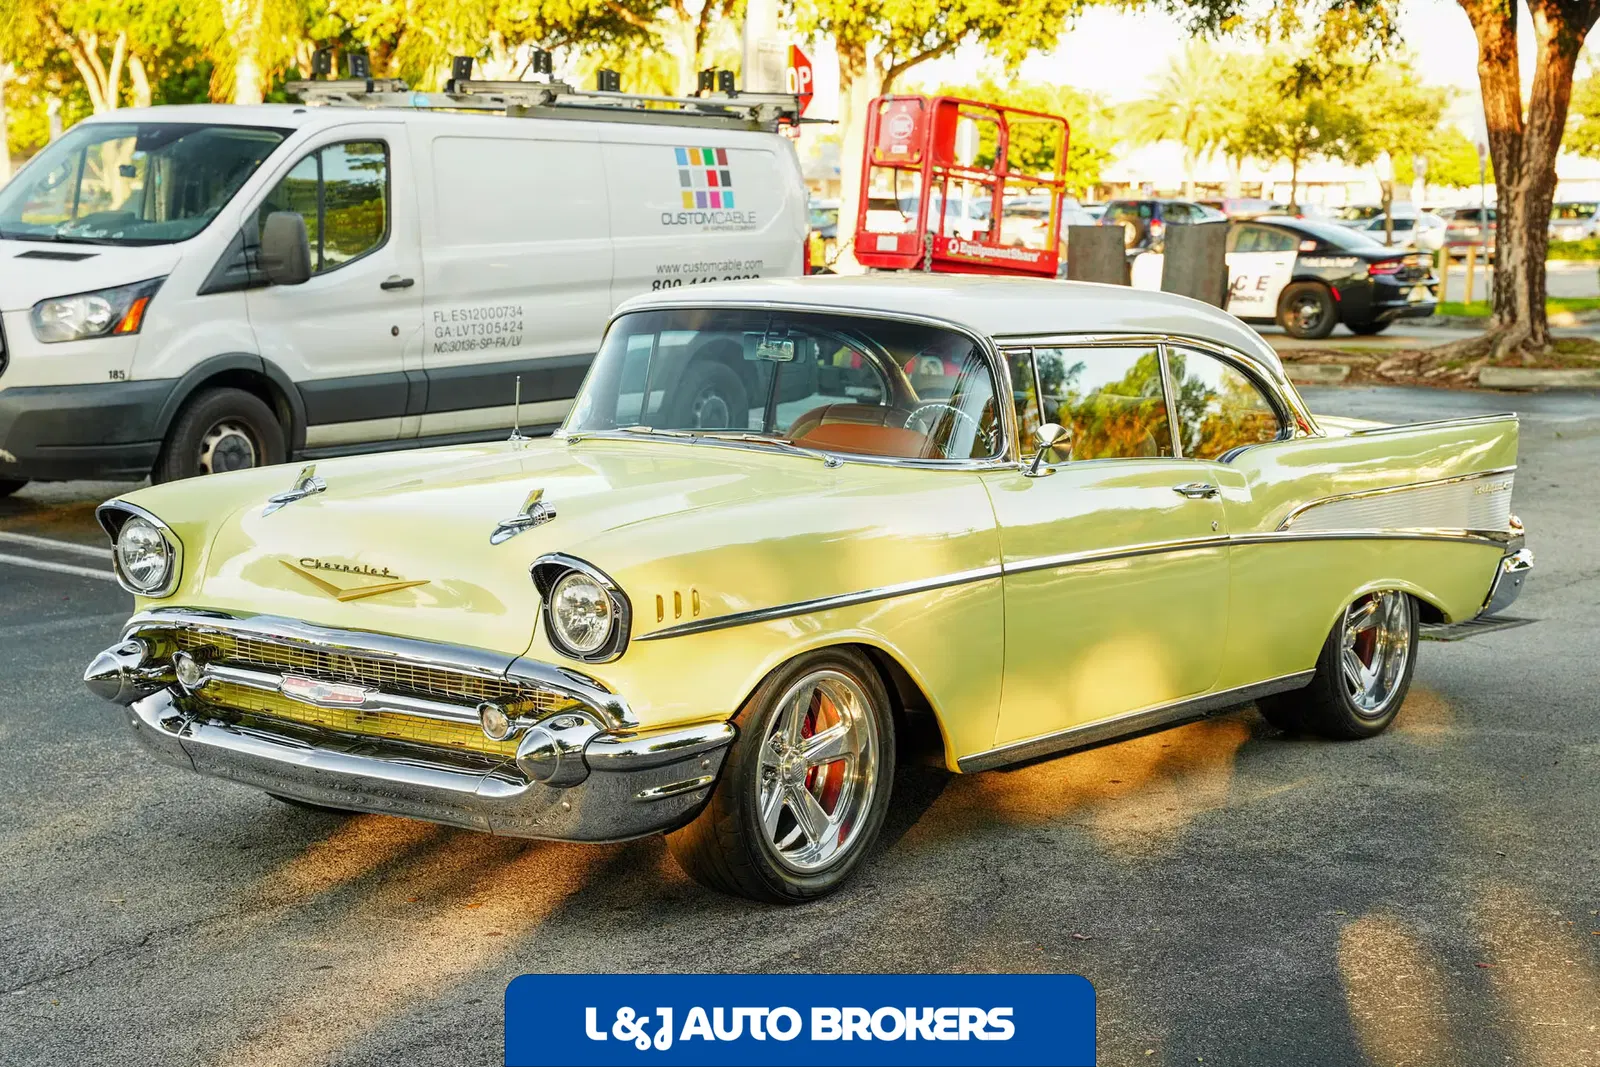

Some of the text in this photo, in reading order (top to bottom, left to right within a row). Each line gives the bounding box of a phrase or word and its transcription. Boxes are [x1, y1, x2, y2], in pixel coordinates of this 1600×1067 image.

[786, 66, 812, 94] OP
[661, 211, 757, 225] CUSTOMCABLE
[109, 370, 125, 380] 185
[299, 558, 397, 579] Chevrolet
